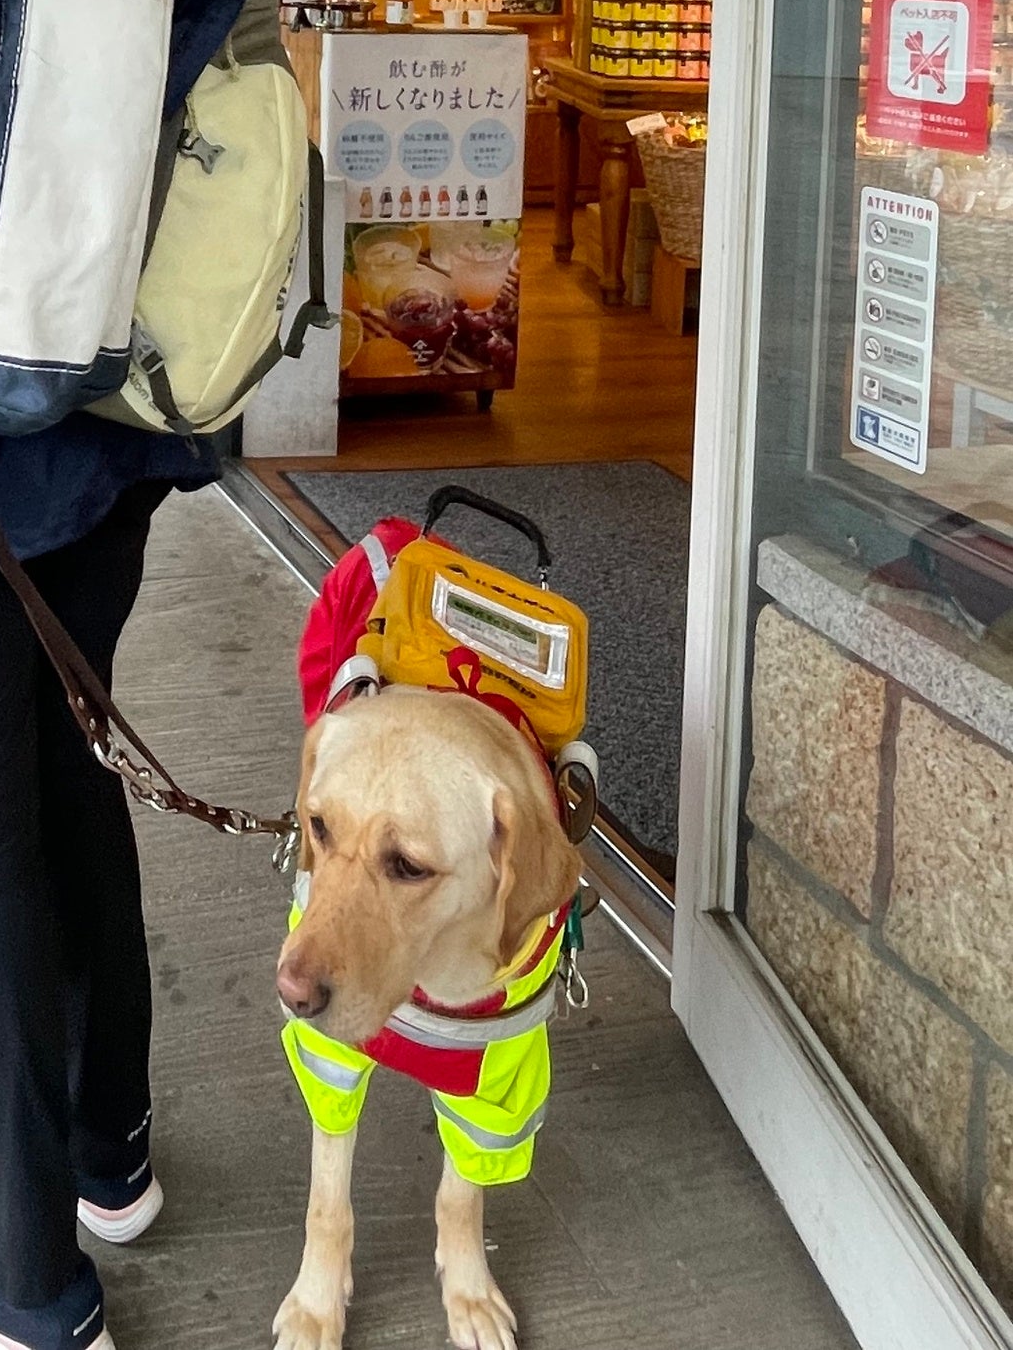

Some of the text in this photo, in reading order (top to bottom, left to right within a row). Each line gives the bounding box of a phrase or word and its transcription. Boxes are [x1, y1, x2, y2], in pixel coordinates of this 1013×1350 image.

[388, 59, 467, 79] 飲む酢が
[867, 195, 934, 222] ATTENTION
